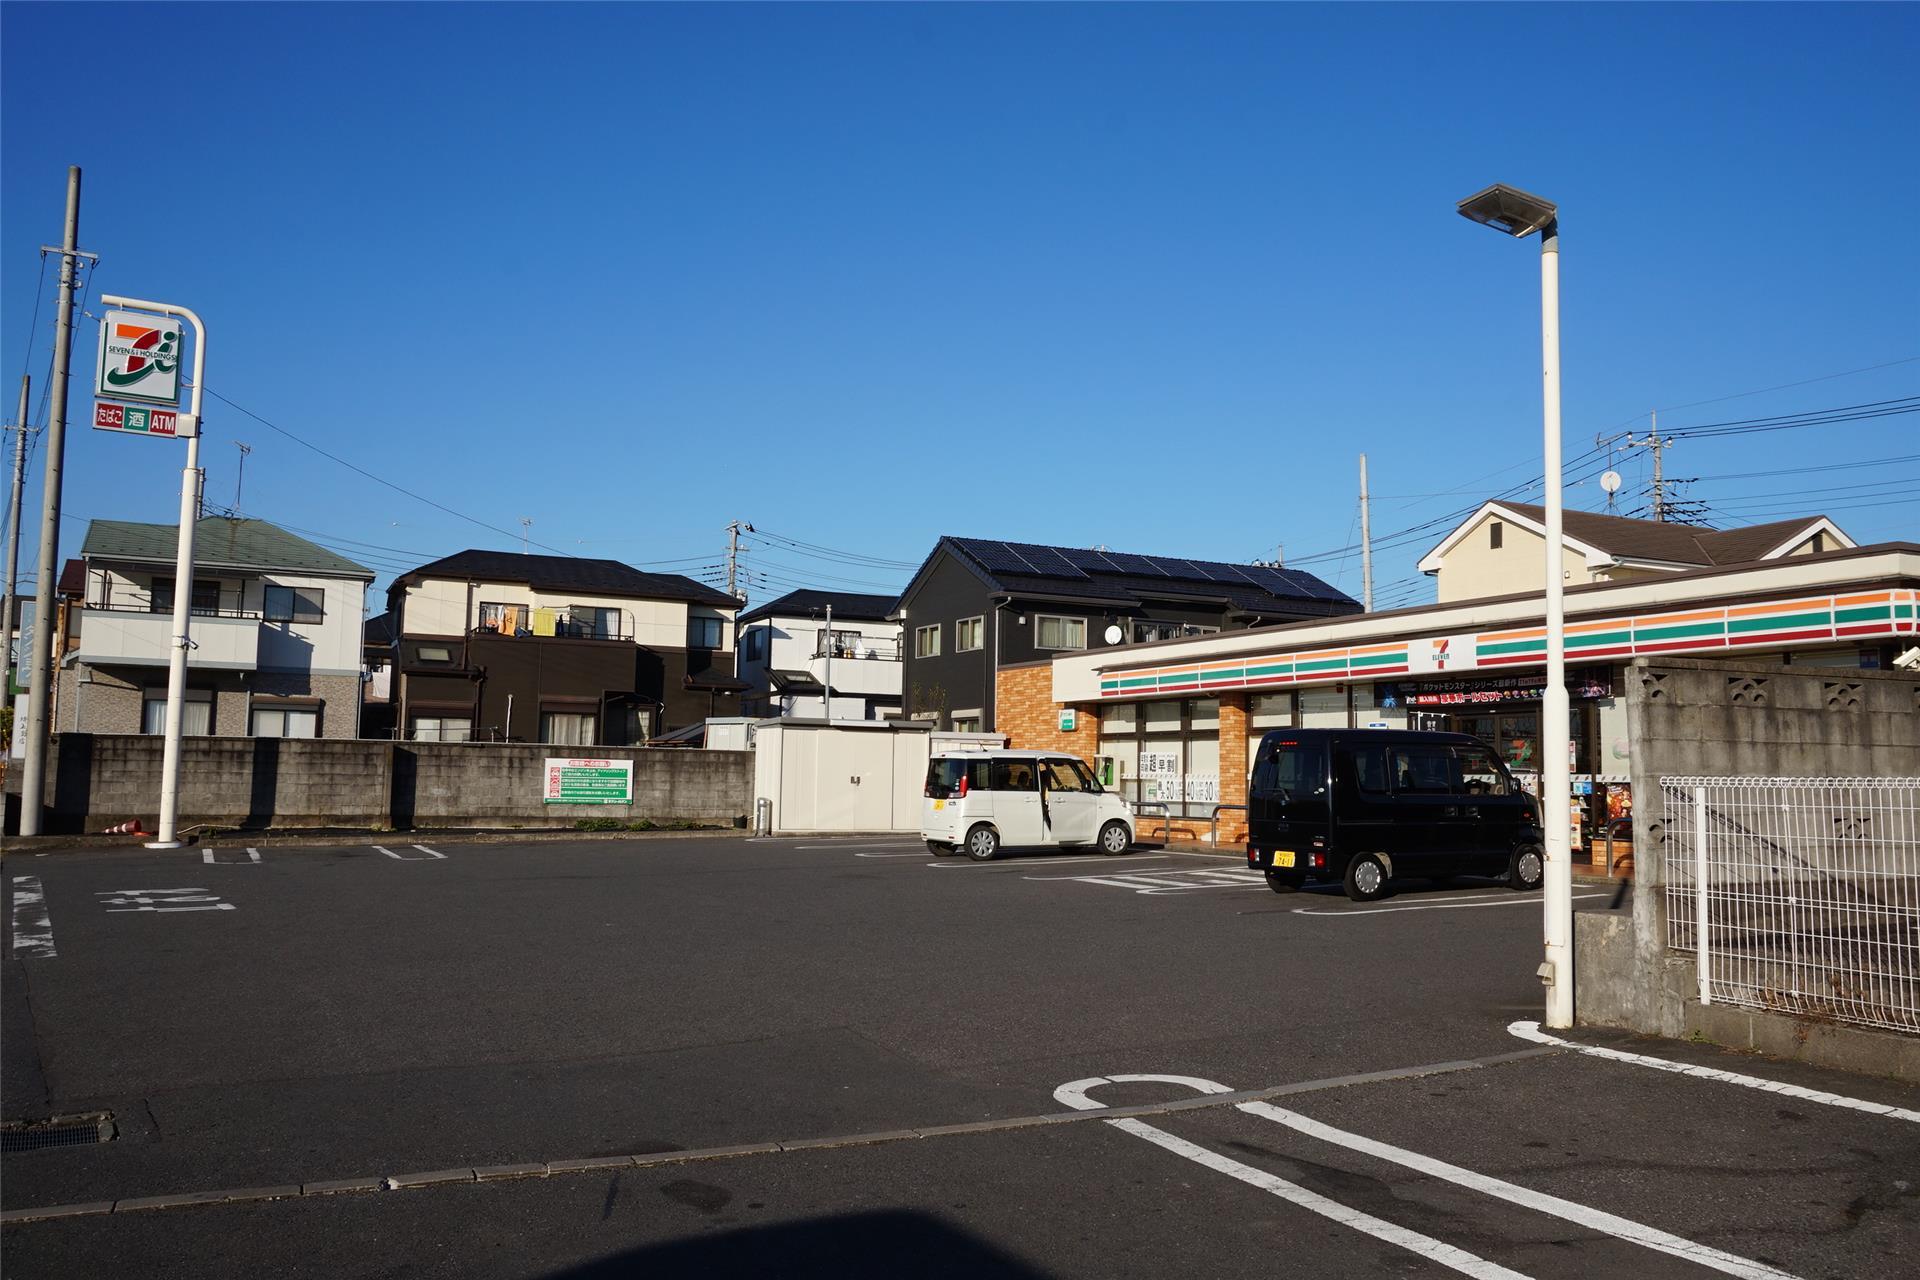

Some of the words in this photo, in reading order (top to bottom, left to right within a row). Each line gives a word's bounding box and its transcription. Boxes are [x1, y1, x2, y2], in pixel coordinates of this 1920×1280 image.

[97, 407, 123, 424] たばこ
[128, 411, 145, 427] 酒
[151, 414, 175, 431] ATM
